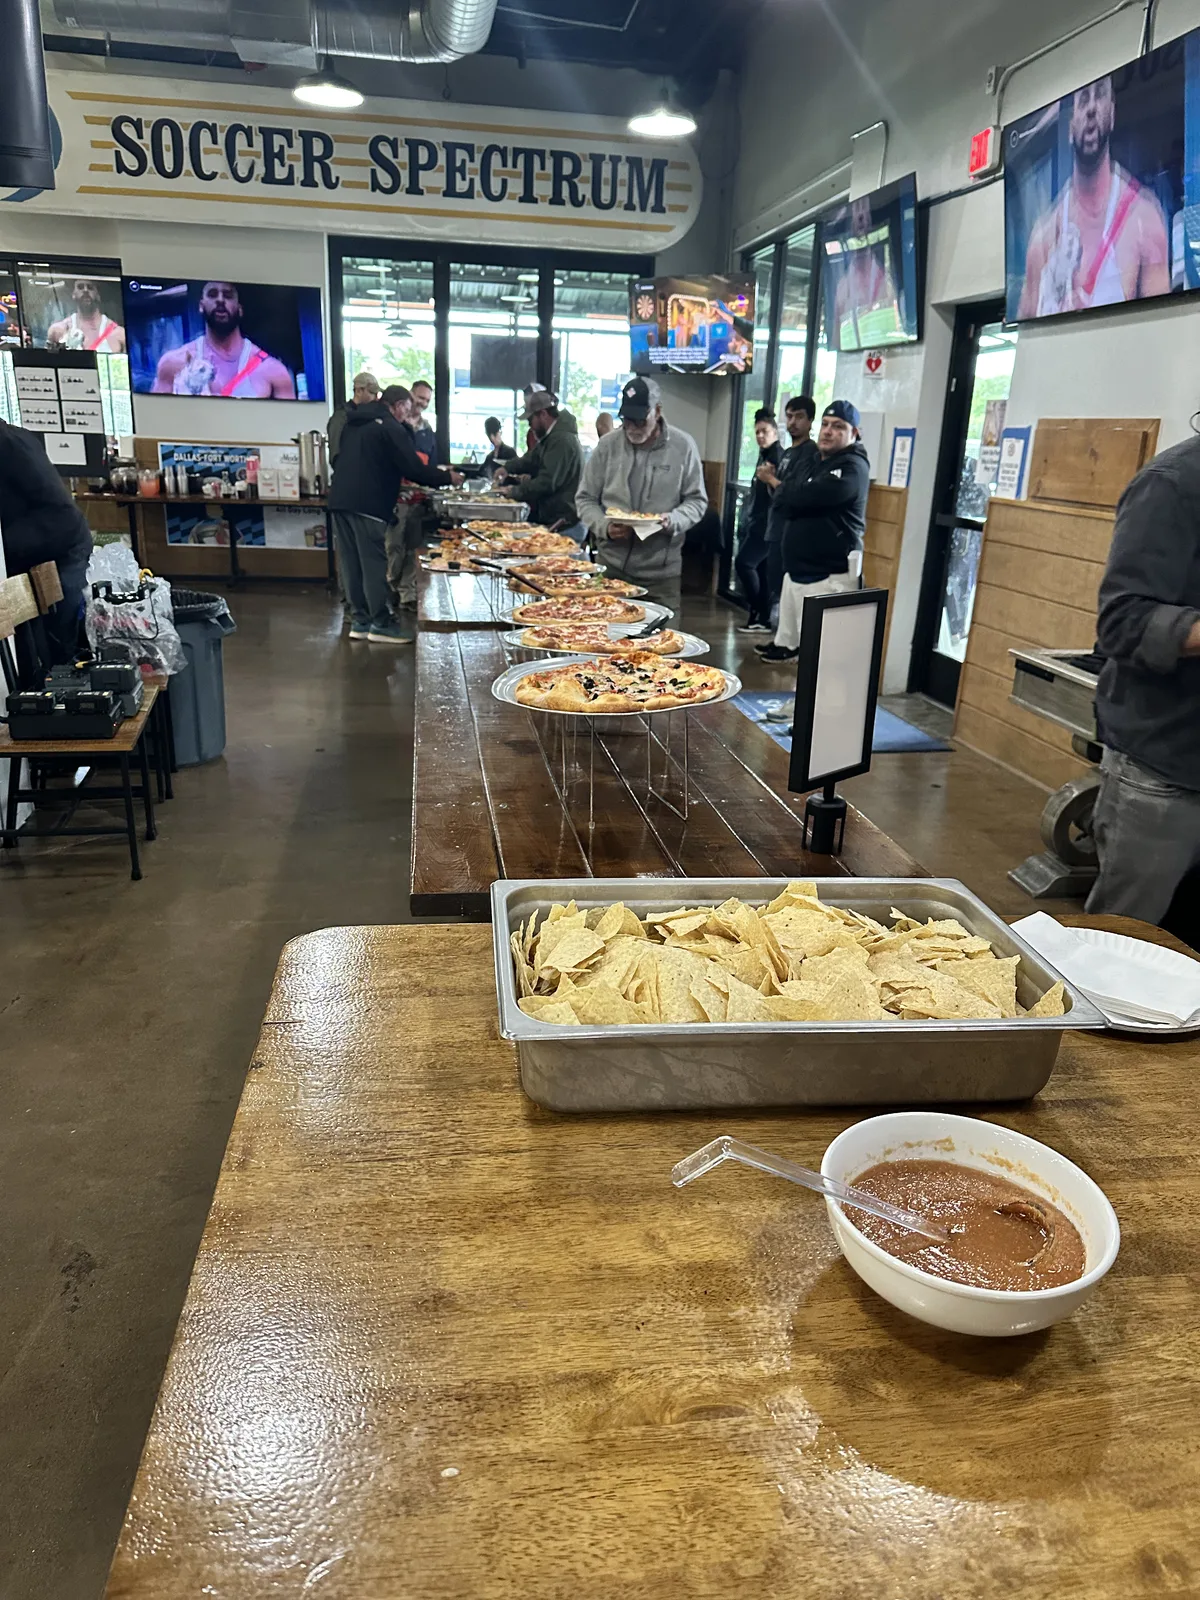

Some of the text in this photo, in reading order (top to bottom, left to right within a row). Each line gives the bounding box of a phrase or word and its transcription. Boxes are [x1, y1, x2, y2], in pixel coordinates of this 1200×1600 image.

[110, 115, 669, 214] SOCCER SPECTRUM
[969, 129, 991, 173] EXIT
[173, 452, 222, 462] DALLAS-FORT
